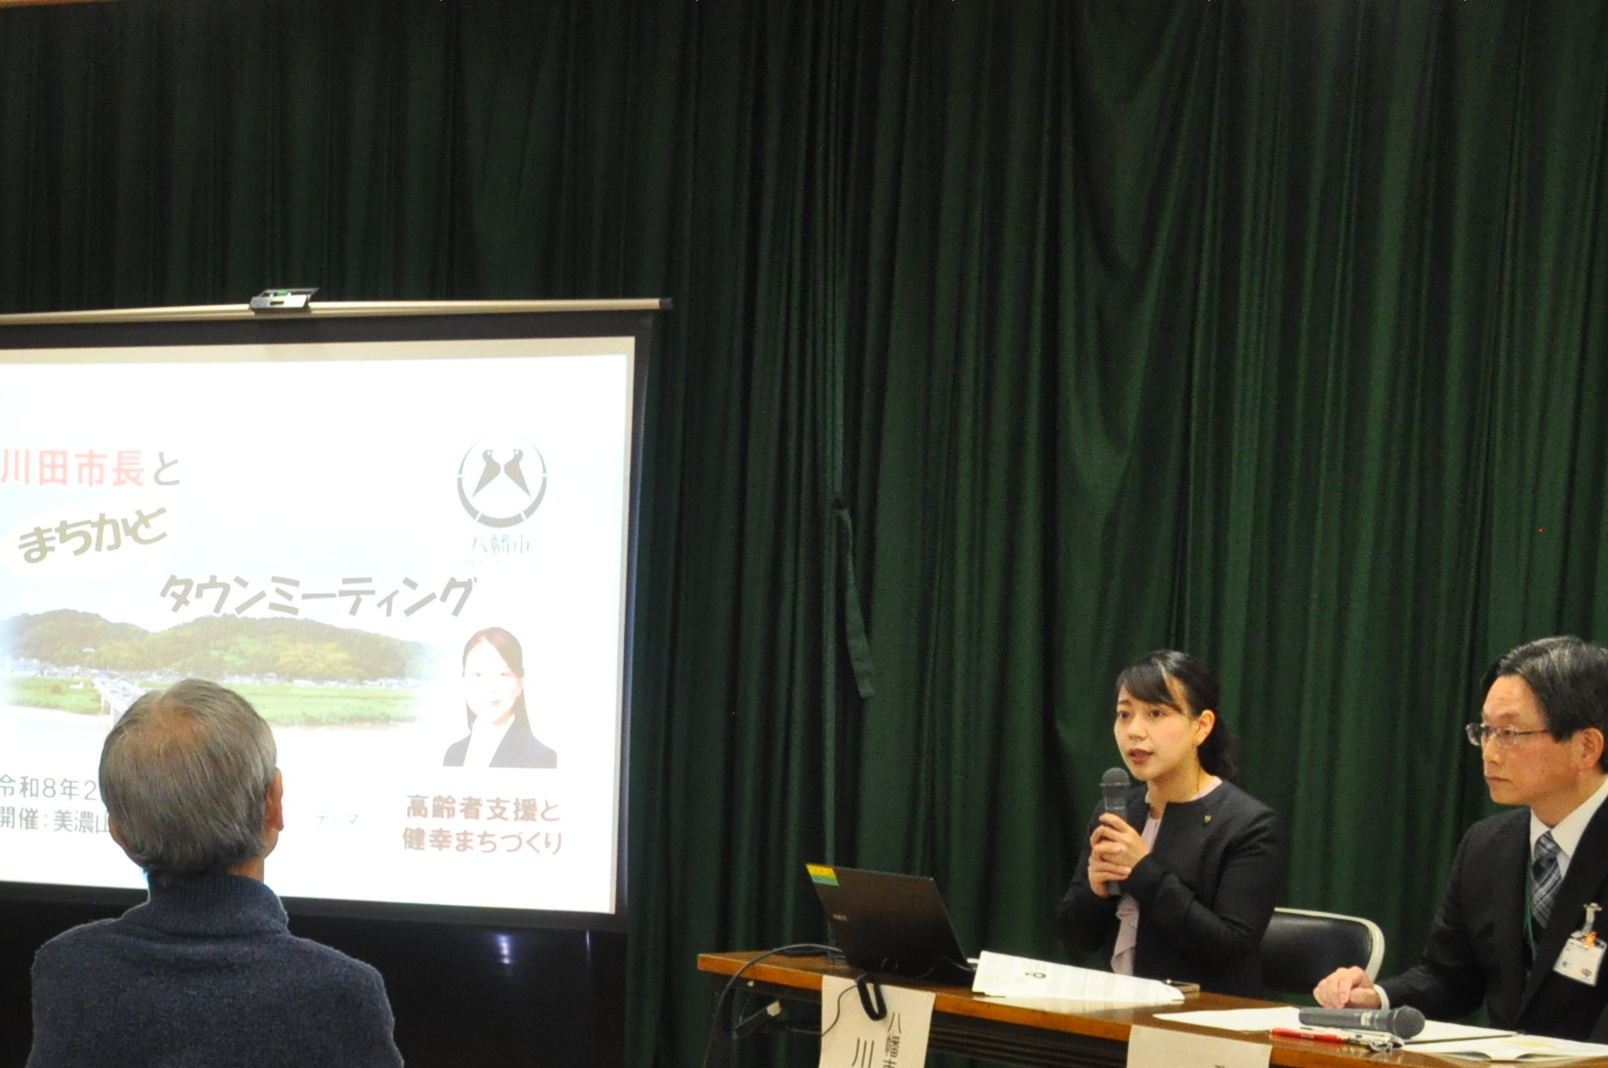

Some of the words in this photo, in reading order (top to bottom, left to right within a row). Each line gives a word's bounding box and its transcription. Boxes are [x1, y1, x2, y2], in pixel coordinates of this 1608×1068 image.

[0, 448, 181, 487] 川田市長と
[160, 574, 478, 618] タウンミーティング
[406, 794, 561, 823] 高齢者支援と
[402, 827, 563, 855] 健幸まちづくり
